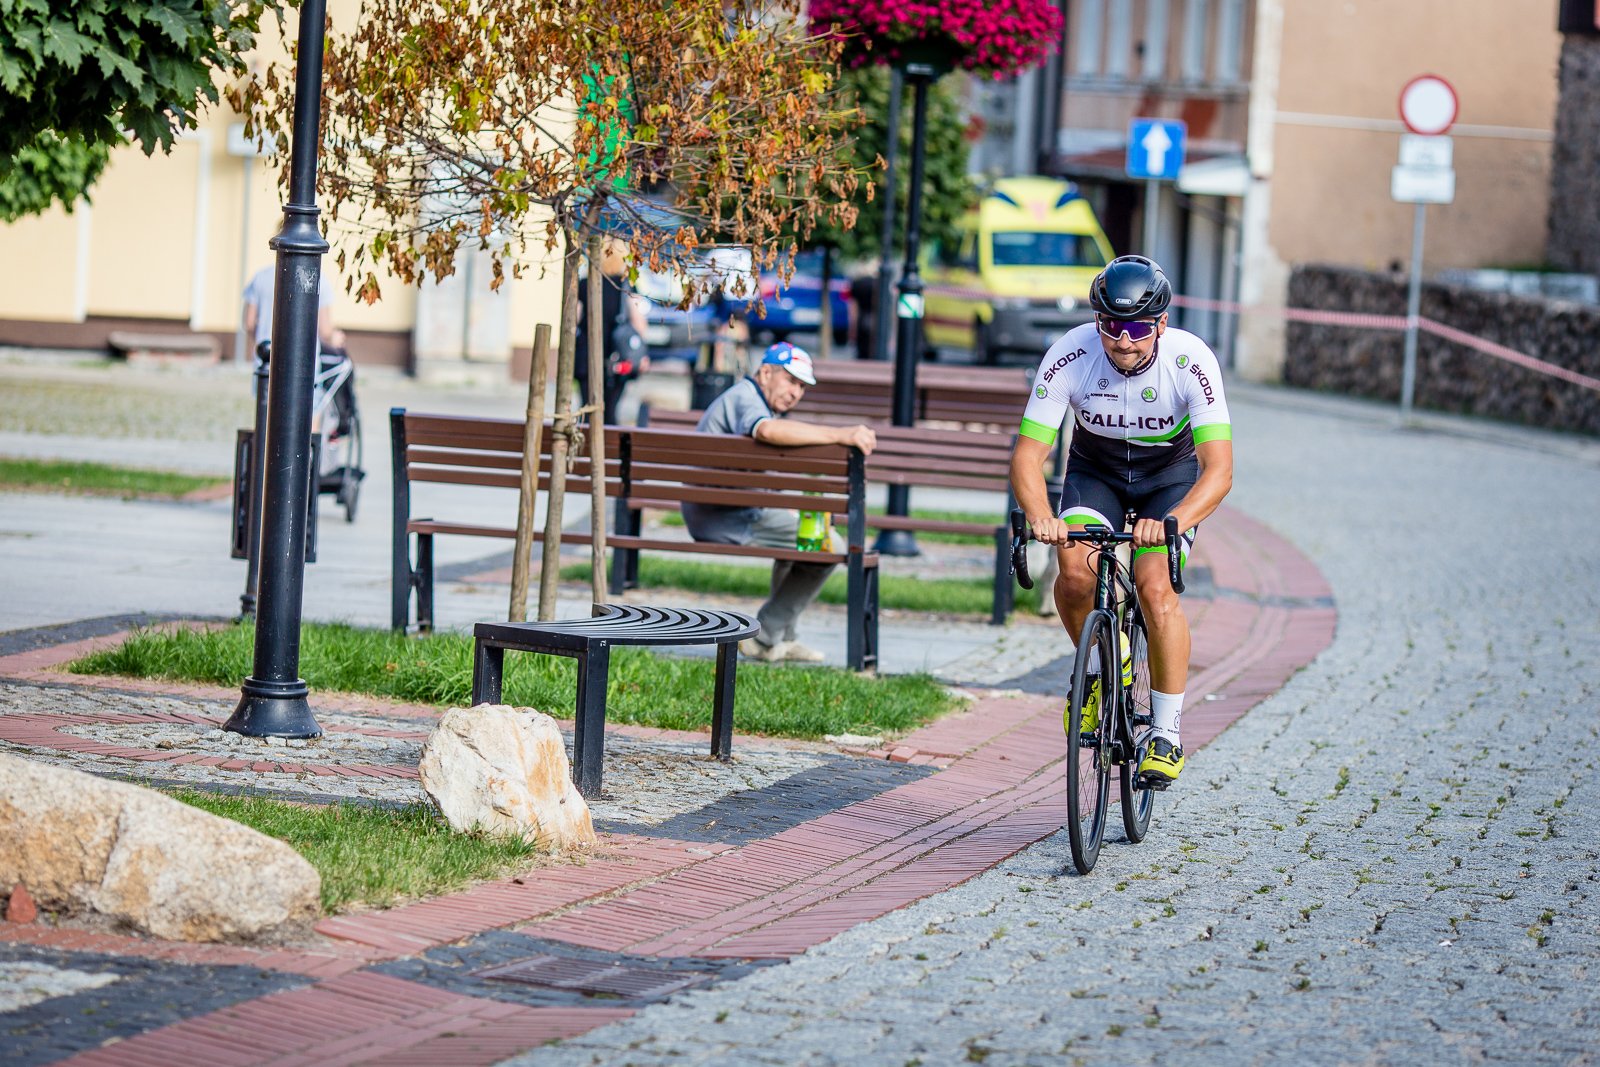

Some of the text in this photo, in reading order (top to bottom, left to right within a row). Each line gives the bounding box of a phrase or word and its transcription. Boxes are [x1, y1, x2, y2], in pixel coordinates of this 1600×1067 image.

[1043, 347, 1088, 384] ŠKODA
[1189, 363, 1215, 406] ŠKODA
[1081, 409, 1175, 430] GALL-ICM
